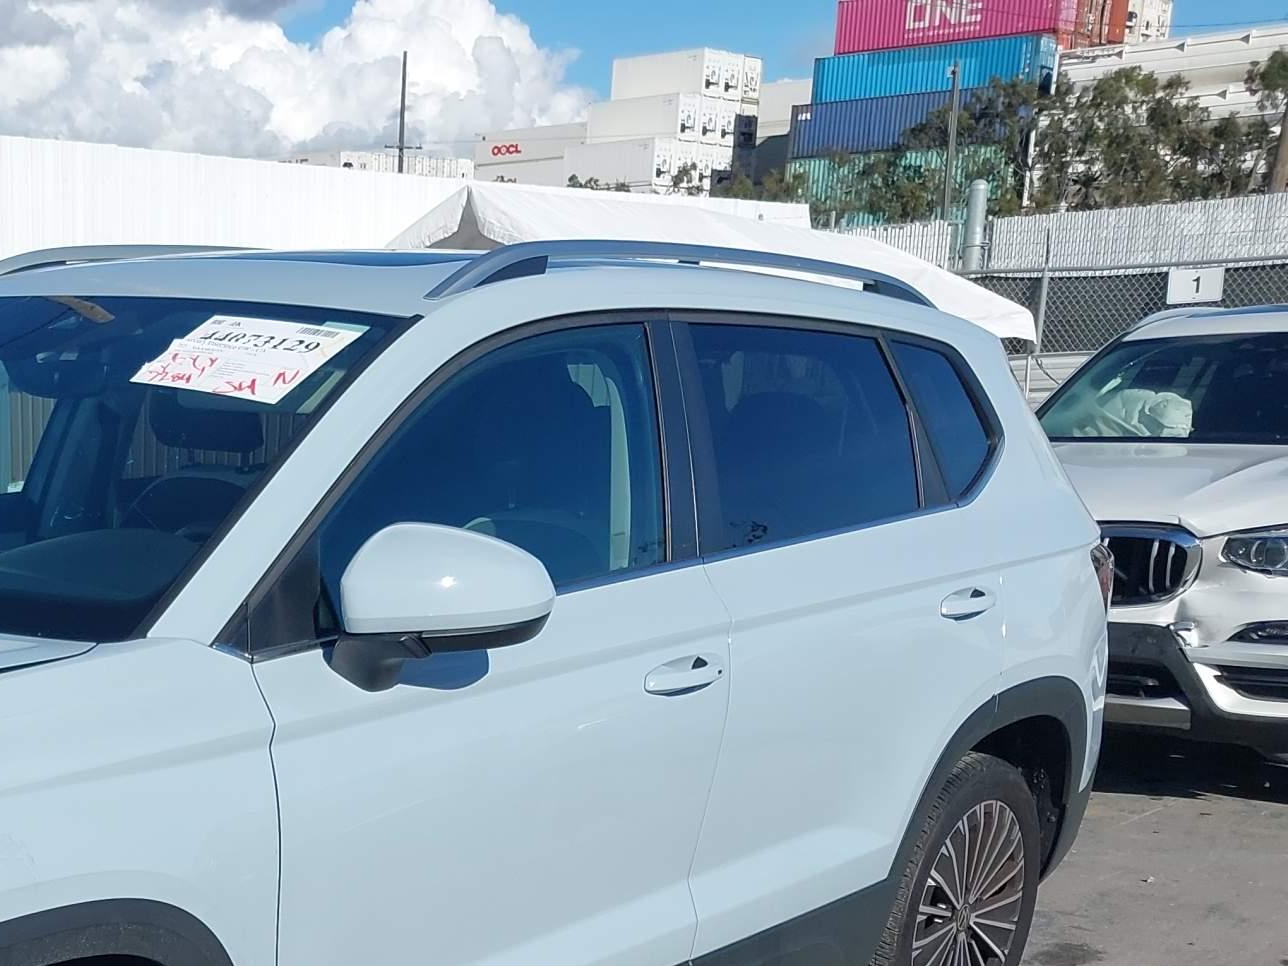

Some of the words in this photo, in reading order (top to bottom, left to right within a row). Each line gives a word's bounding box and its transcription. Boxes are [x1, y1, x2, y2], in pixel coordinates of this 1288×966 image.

[906, 0, 983, 29] ONE
[491, 143, 522, 157] OOCL
[1191, 276, 1201, 294] 1
